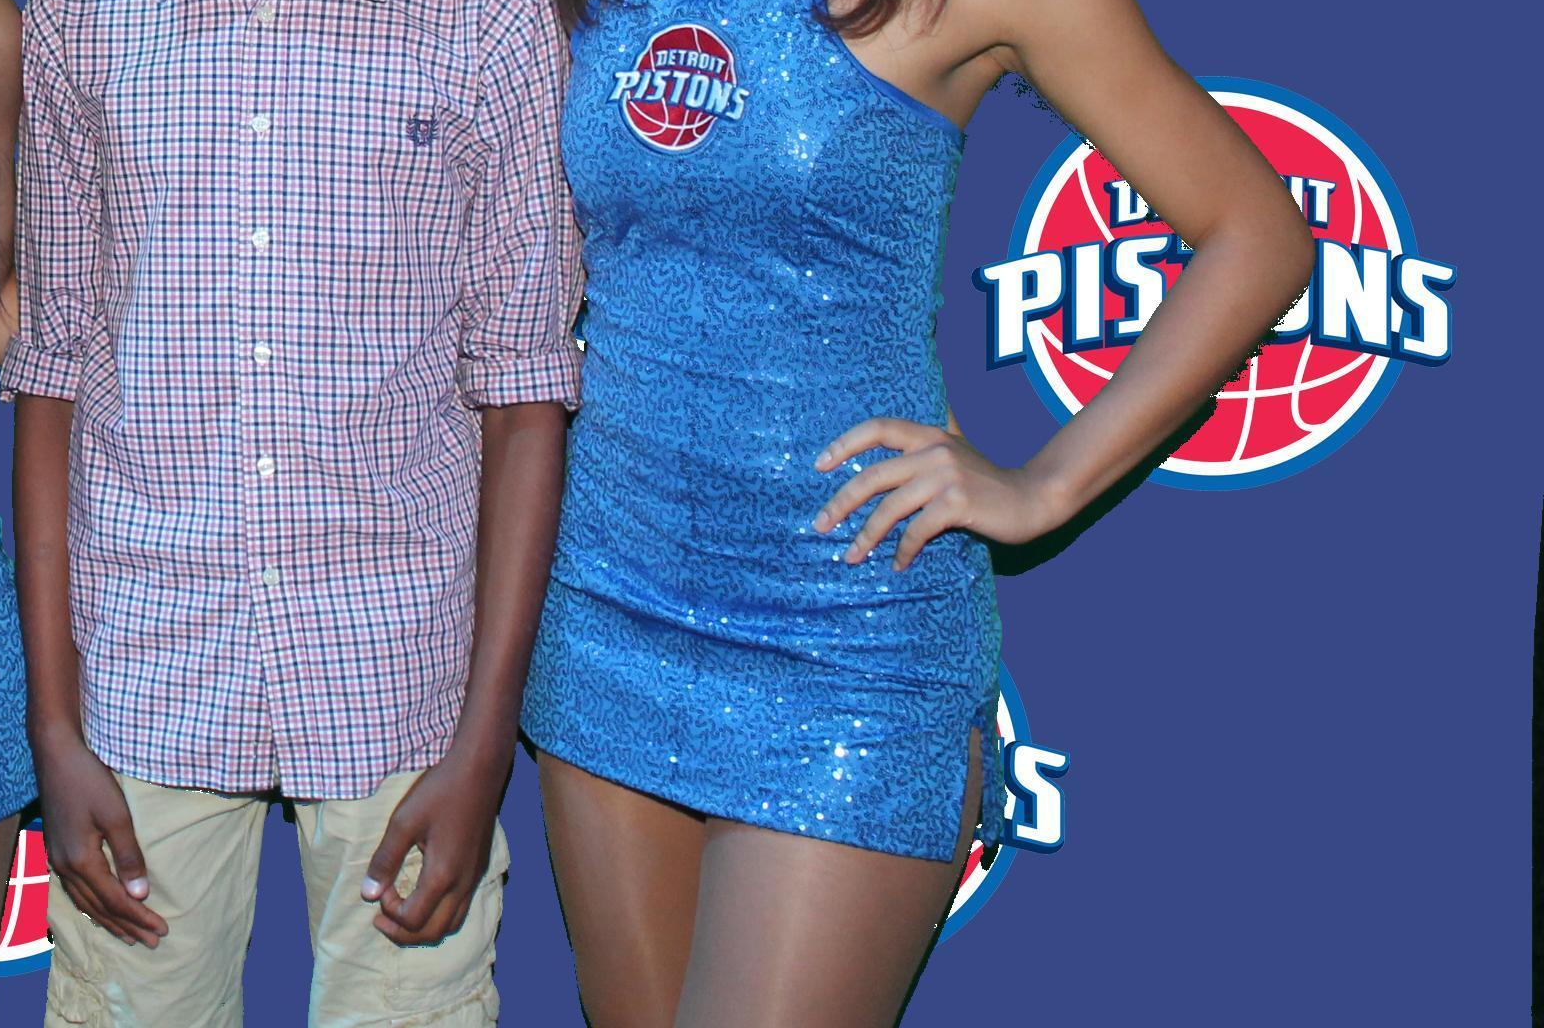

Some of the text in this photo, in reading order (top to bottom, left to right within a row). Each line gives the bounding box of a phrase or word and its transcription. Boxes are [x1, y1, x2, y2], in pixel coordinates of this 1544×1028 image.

[656, 49, 727, 74] DETROIT
[608, 69, 750, 120] PISTONS
[973, 232, 1456, 368] PISNS
